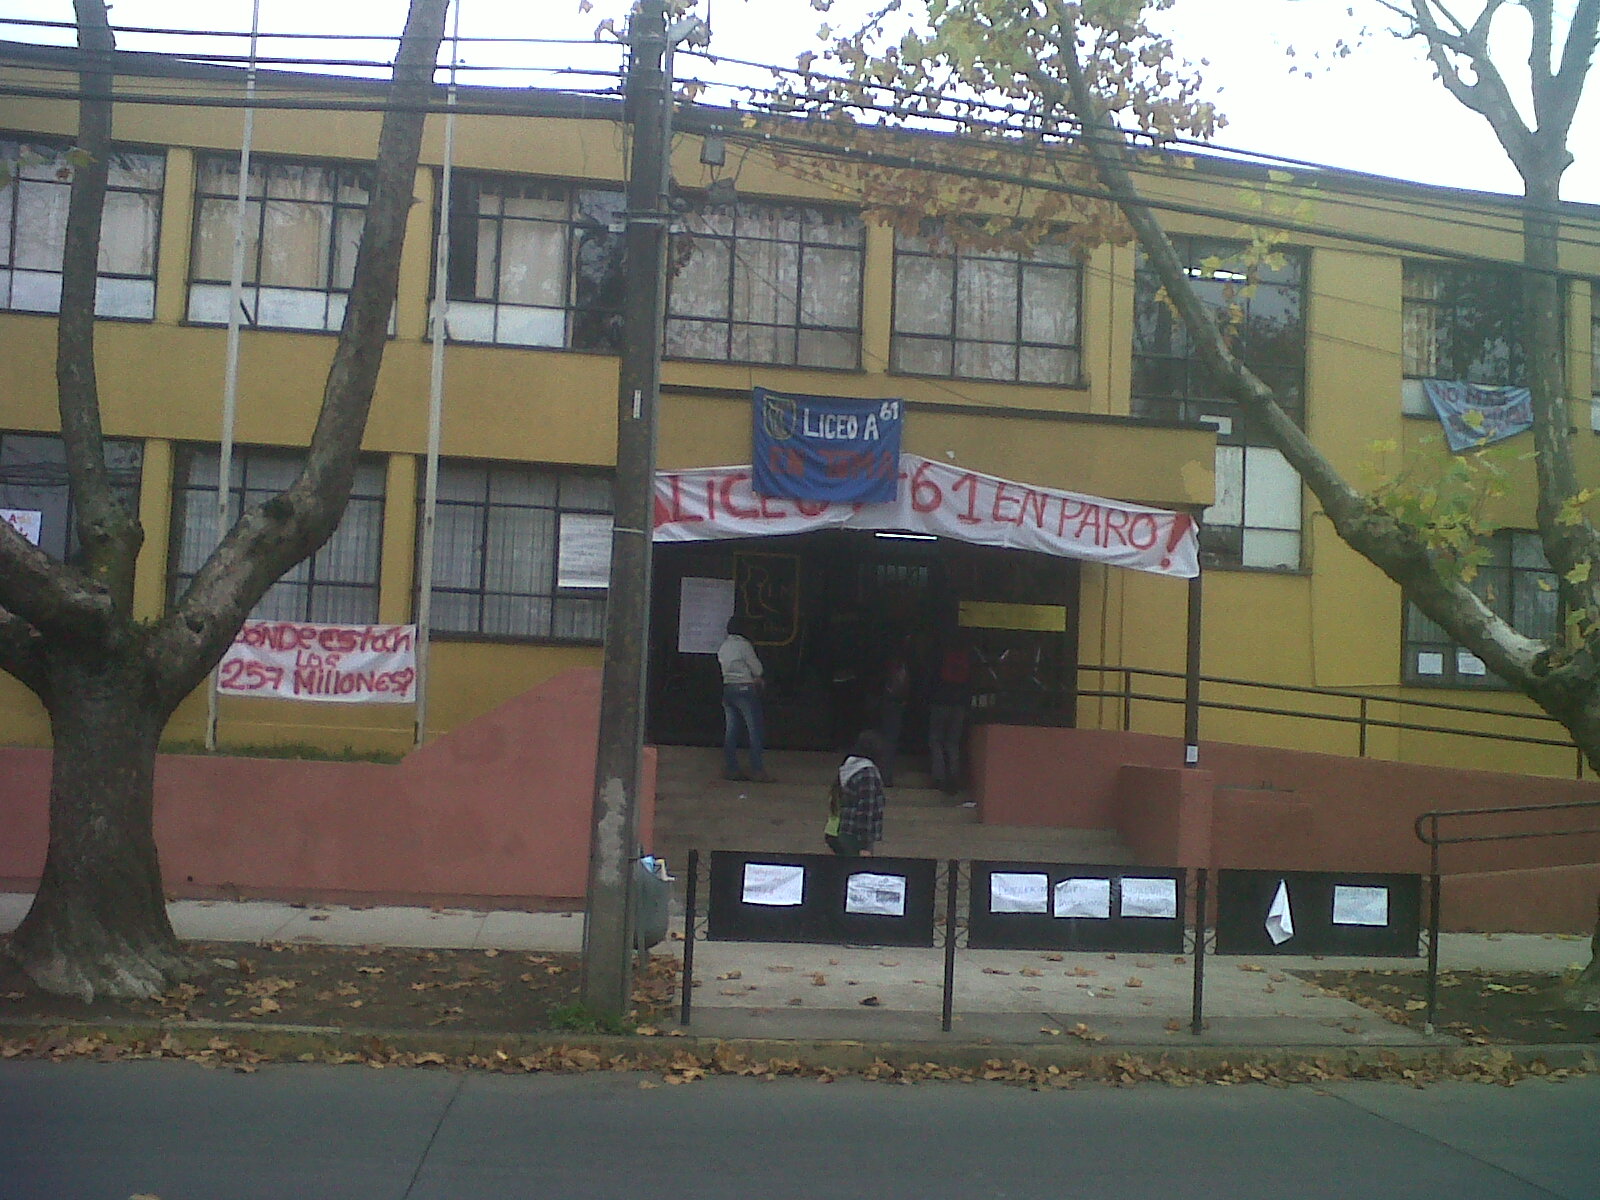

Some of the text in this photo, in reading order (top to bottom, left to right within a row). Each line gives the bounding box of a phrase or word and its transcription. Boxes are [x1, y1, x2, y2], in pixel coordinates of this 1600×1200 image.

[803, 408, 859, 440] LICEO
[992, 482, 1050, 528] EN
[1058, 497, 1192, 568] PARO!
[220, 658, 285, 691] 257
